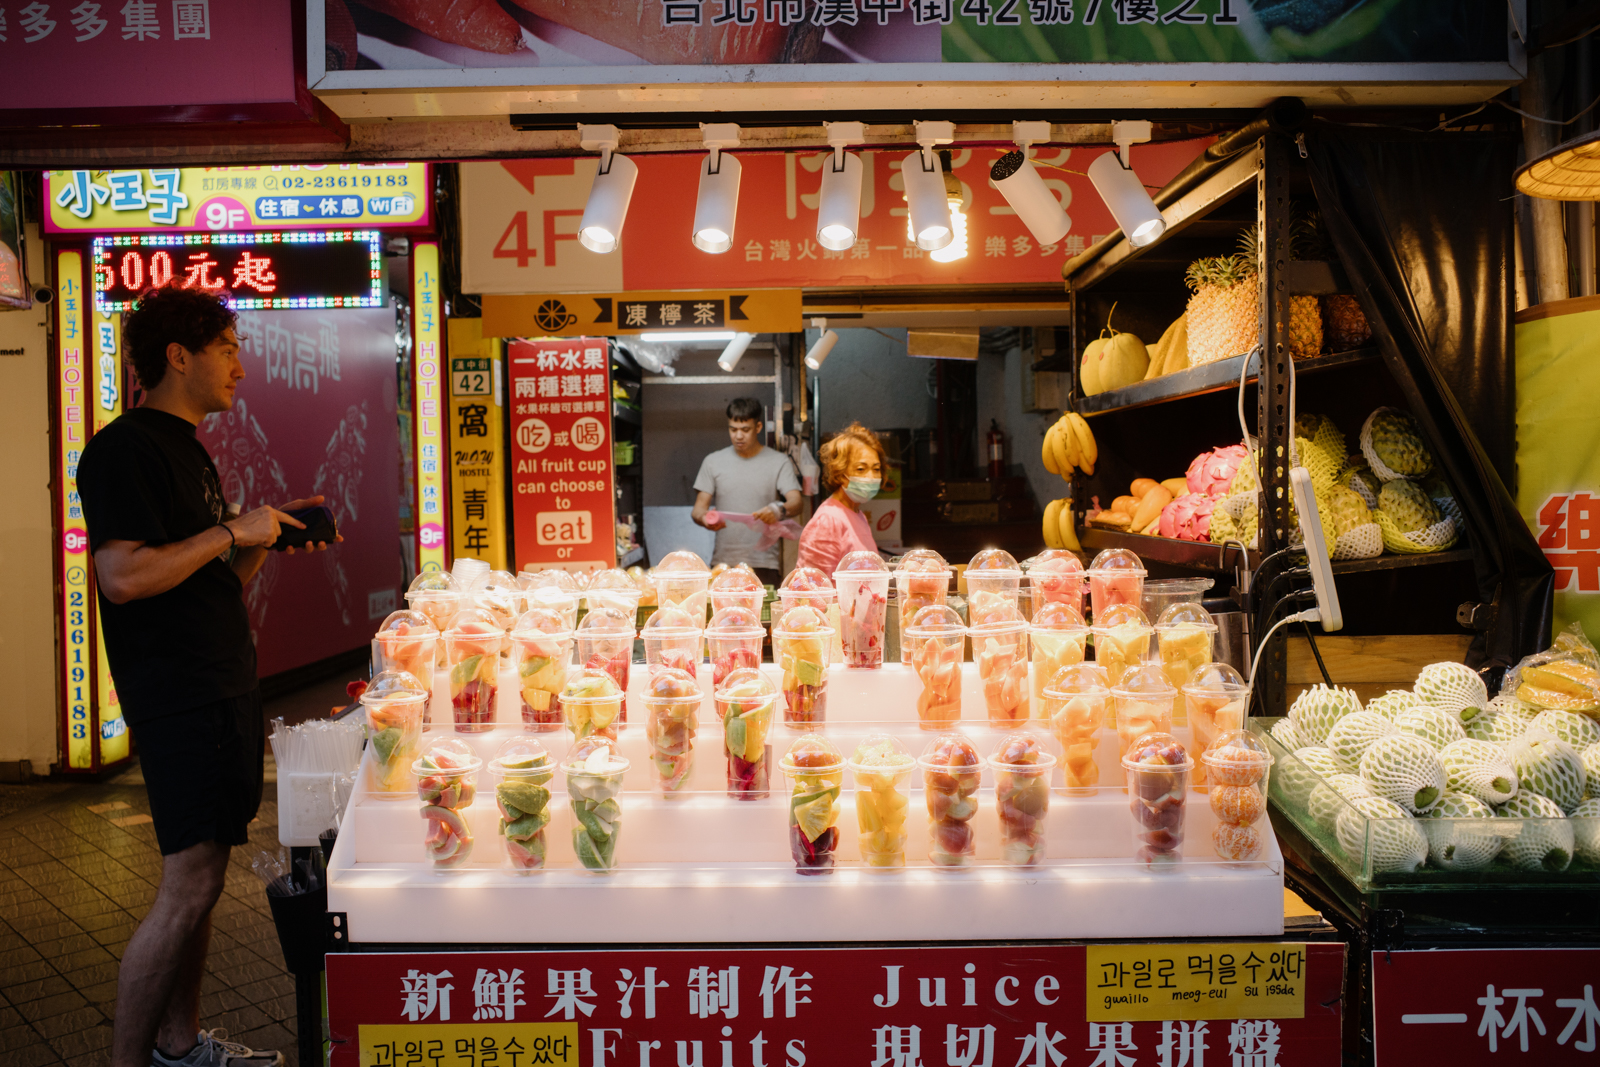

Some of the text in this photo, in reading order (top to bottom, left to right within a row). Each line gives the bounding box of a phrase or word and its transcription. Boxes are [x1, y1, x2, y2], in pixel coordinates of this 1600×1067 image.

[0, 0, 211, 43] 多多集團
[56, 170, 188, 224] 小王子
[202, 175, 408, 191] 訂房專線 02-23619183
[206, 197, 408, 230] 9F 住宿 休息 WiFi
[493, 210, 584, 268] 4F
[61, 279, 78, 338] 小王子
[418, 271, 435, 332] 小王子
[513, 348, 604, 371] 一杯水果
[63, 347, 81, 442] HOTEL
[418, 341, 438, 437] HOTEL
[459, 374, 484, 392] 42
[514, 374, 605, 398] 兩種選擇
[458, 404, 488, 438] 窩
[422, 444, 438, 514] 住宿 休息
[459, 468, 492, 478] HOSTEL
[517, 458, 607, 475] All fruit cup
[517, 478, 605, 494] can choose
[555, 495, 571, 510] to
[420, 528, 443, 545] 9F
[462, 488, 489, 556] 青年
[541, 516, 587, 541] eat
[64, 532, 87, 550] 9F
[556, 547, 574, 559] or
[69, 591, 86, 740] 23619183
[873, 963, 1061, 1008] Juice
[1098, 959, 1177, 989] 과일로
[400, 965, 814, 1021] 新鮮果汁制作
[587, 1025, 809, 1067] Fruits
[871, 1019, 1283, 1067] 現切水果拼盤
